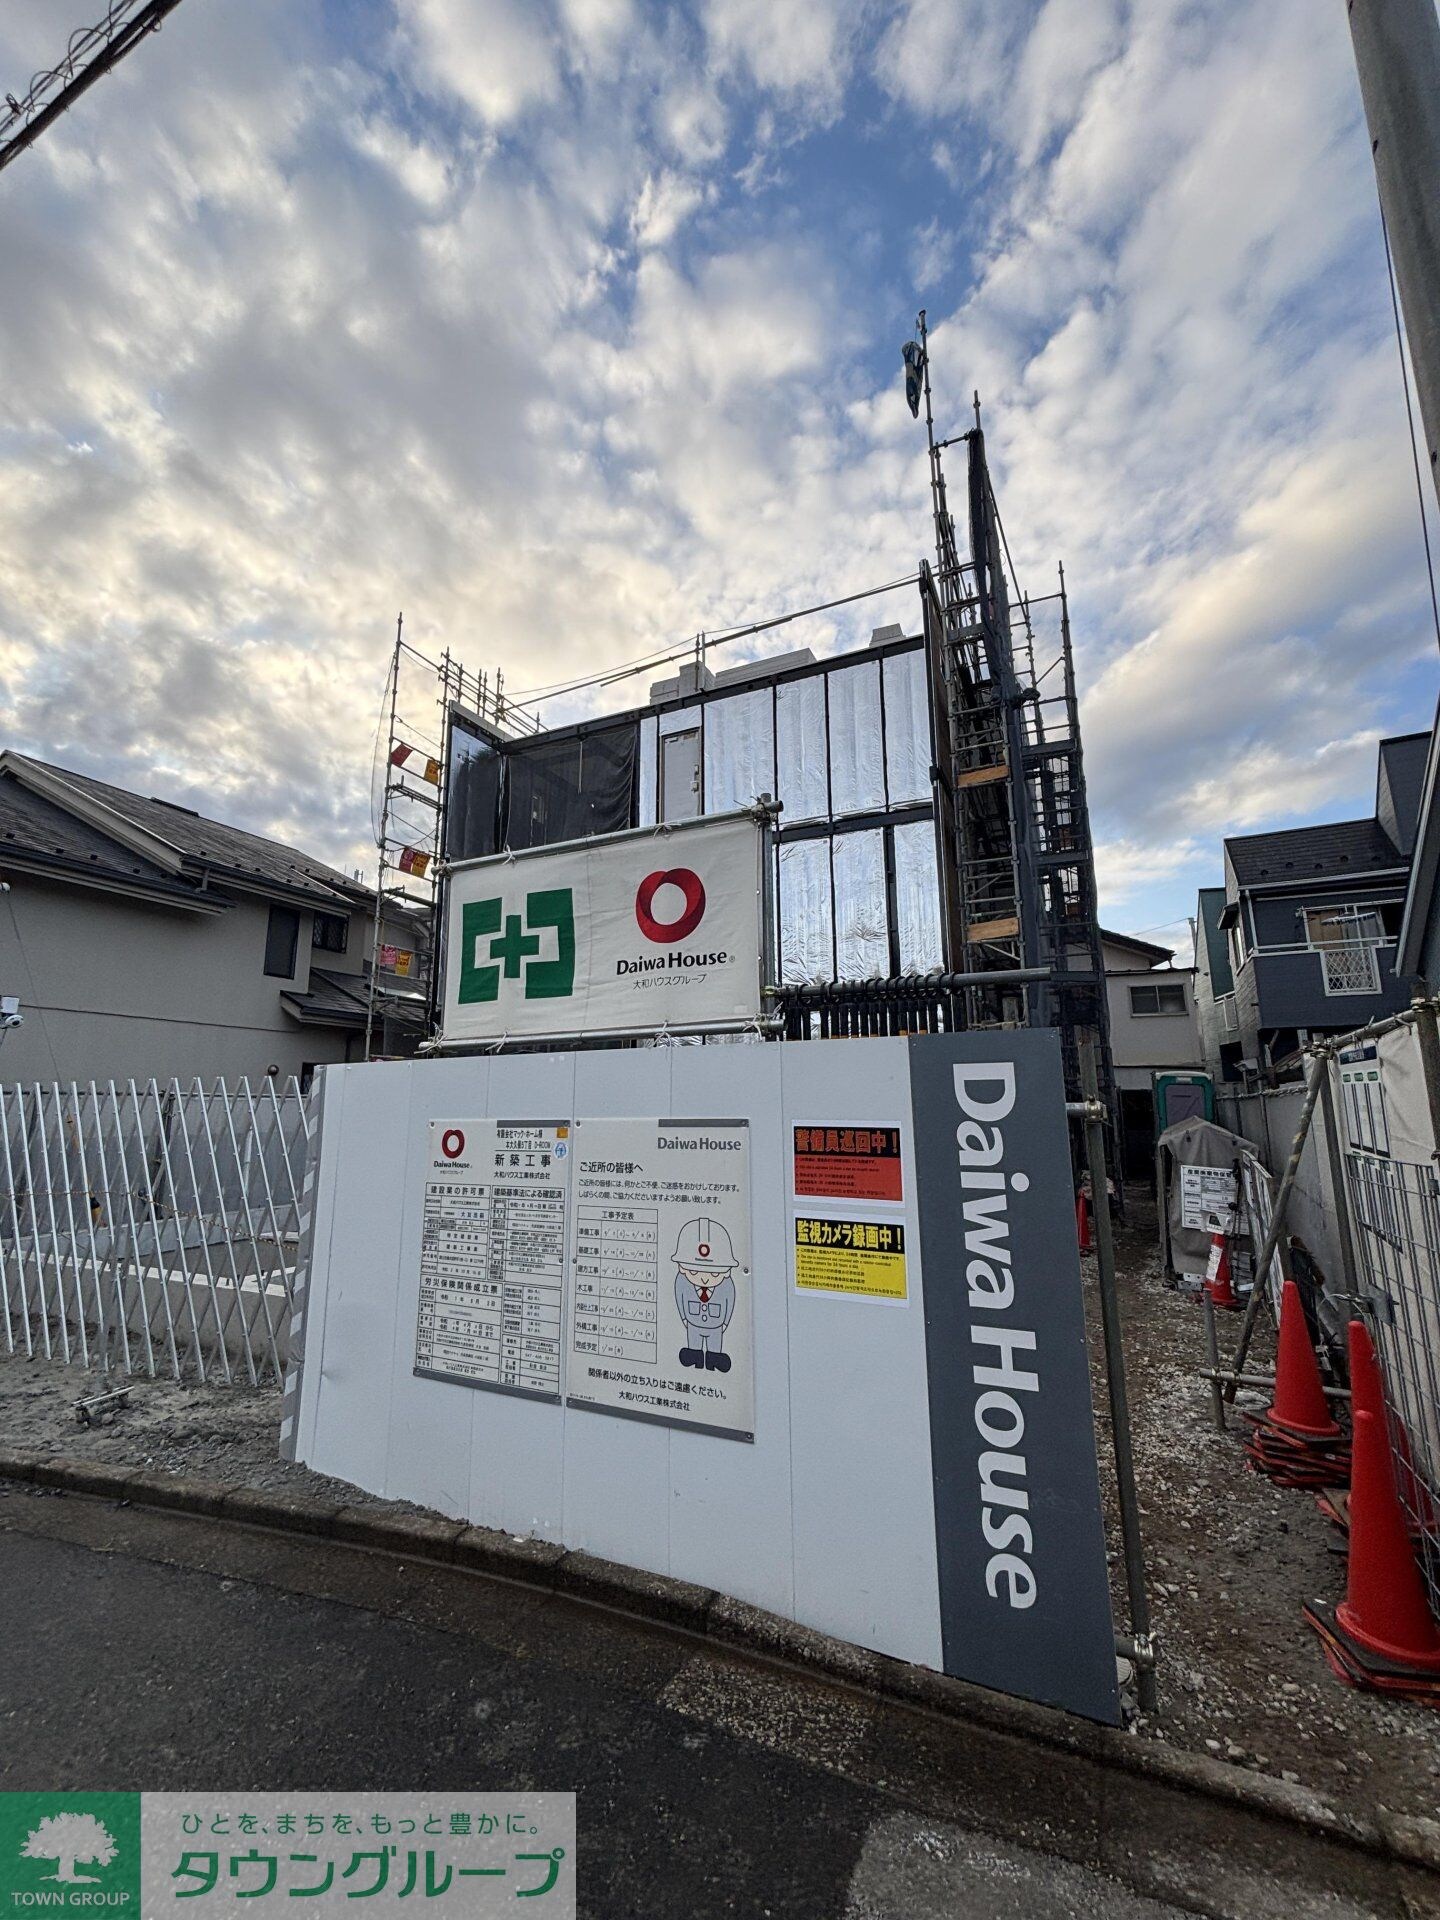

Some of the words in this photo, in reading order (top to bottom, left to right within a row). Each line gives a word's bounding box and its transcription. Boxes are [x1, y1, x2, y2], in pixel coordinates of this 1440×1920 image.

[616, 954, 665, 976] Daiwa
[668, 951, 728, 970] House
[633, 974, 707, 989] 大和ハウスグループ
[657, 1136, 697, 1150] Daiwa
[699, 1137, 742, 1151] House
[433, 1160, 451, 1168] Daiwa
[452, 1161, 470, 1169] House
[495, 1154, 551, 1167] 新築工事
[579, 1161, 644, 1173] ご近所の皆様へ
[494, 1170, 550, 1180] 大和ハウス工業株式会社
[952, 1061, 1030, 1312] Daiwa
[601, 1210, 635, 1220] 工事予定表
[796, 1219, 902, 1250] 監視カメラ録画中！
[424, 1277, 498, 1294] 労災保険関係成立票
[588, 1367, 727, 1400] 関係者以外の立ち入りはご遠慮ください。
[618, 1390, 690, 1412] 大和ハウス工業株式会社
[970, 1324, 1040, 1610] House
